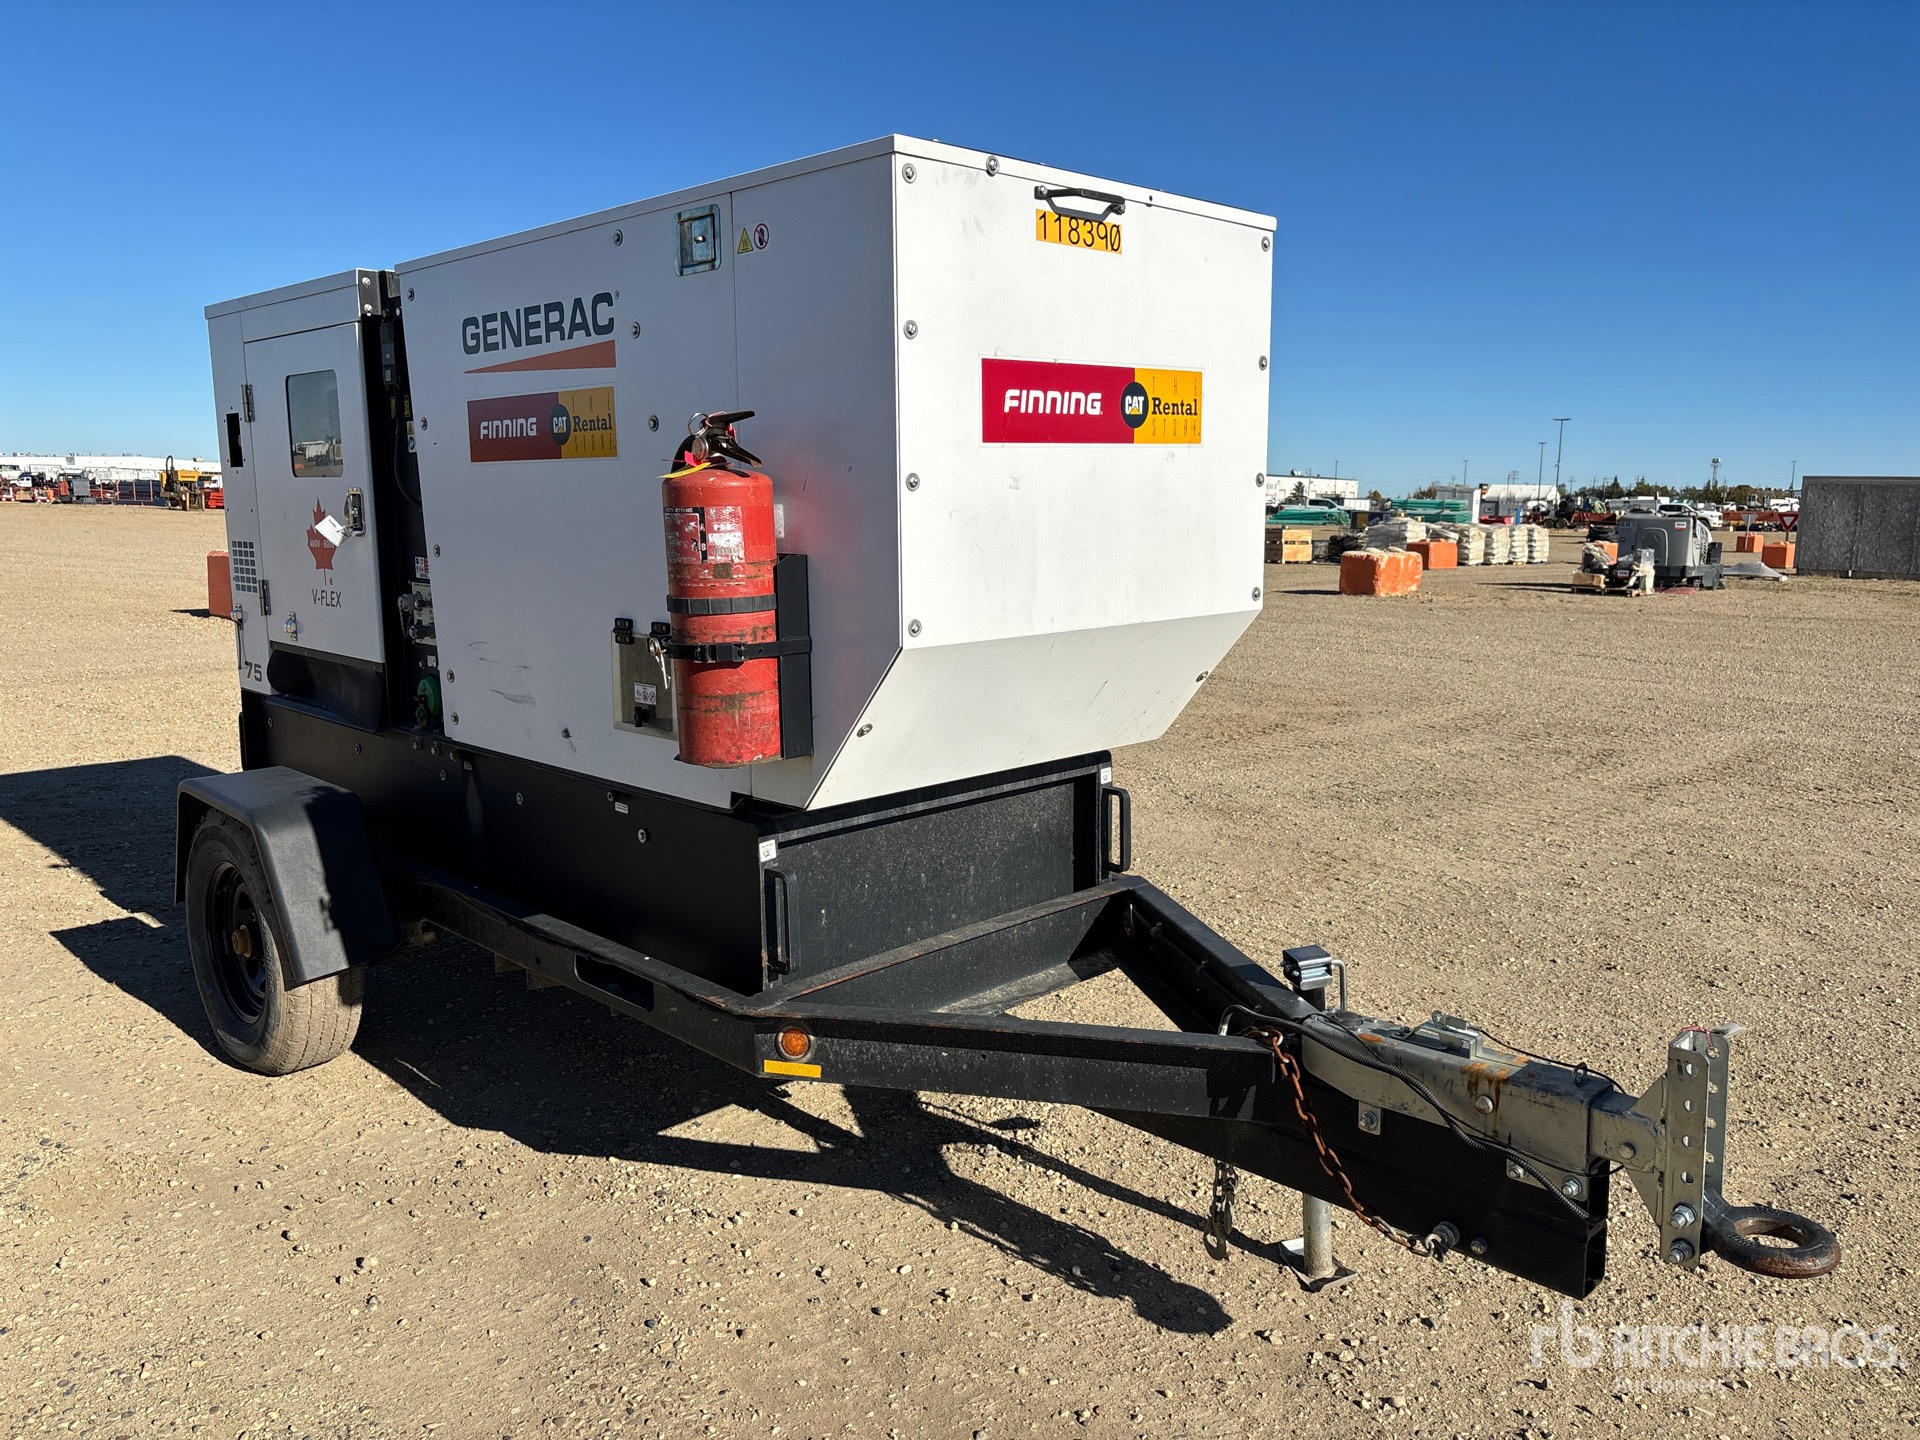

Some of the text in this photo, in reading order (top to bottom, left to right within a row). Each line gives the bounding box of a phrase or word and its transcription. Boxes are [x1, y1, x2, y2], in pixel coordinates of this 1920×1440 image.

[1039, 211, 1121, 252] 118390
[1152, 376, 1198, 397] THE
[1003, 389, 1198, 416] FINNING CAT Rental
[480, 413, 613, 440] FINNING CAT Rental
[311, 588, 342, 608] V-FLEX
[244, 660, 262, 682] 75
